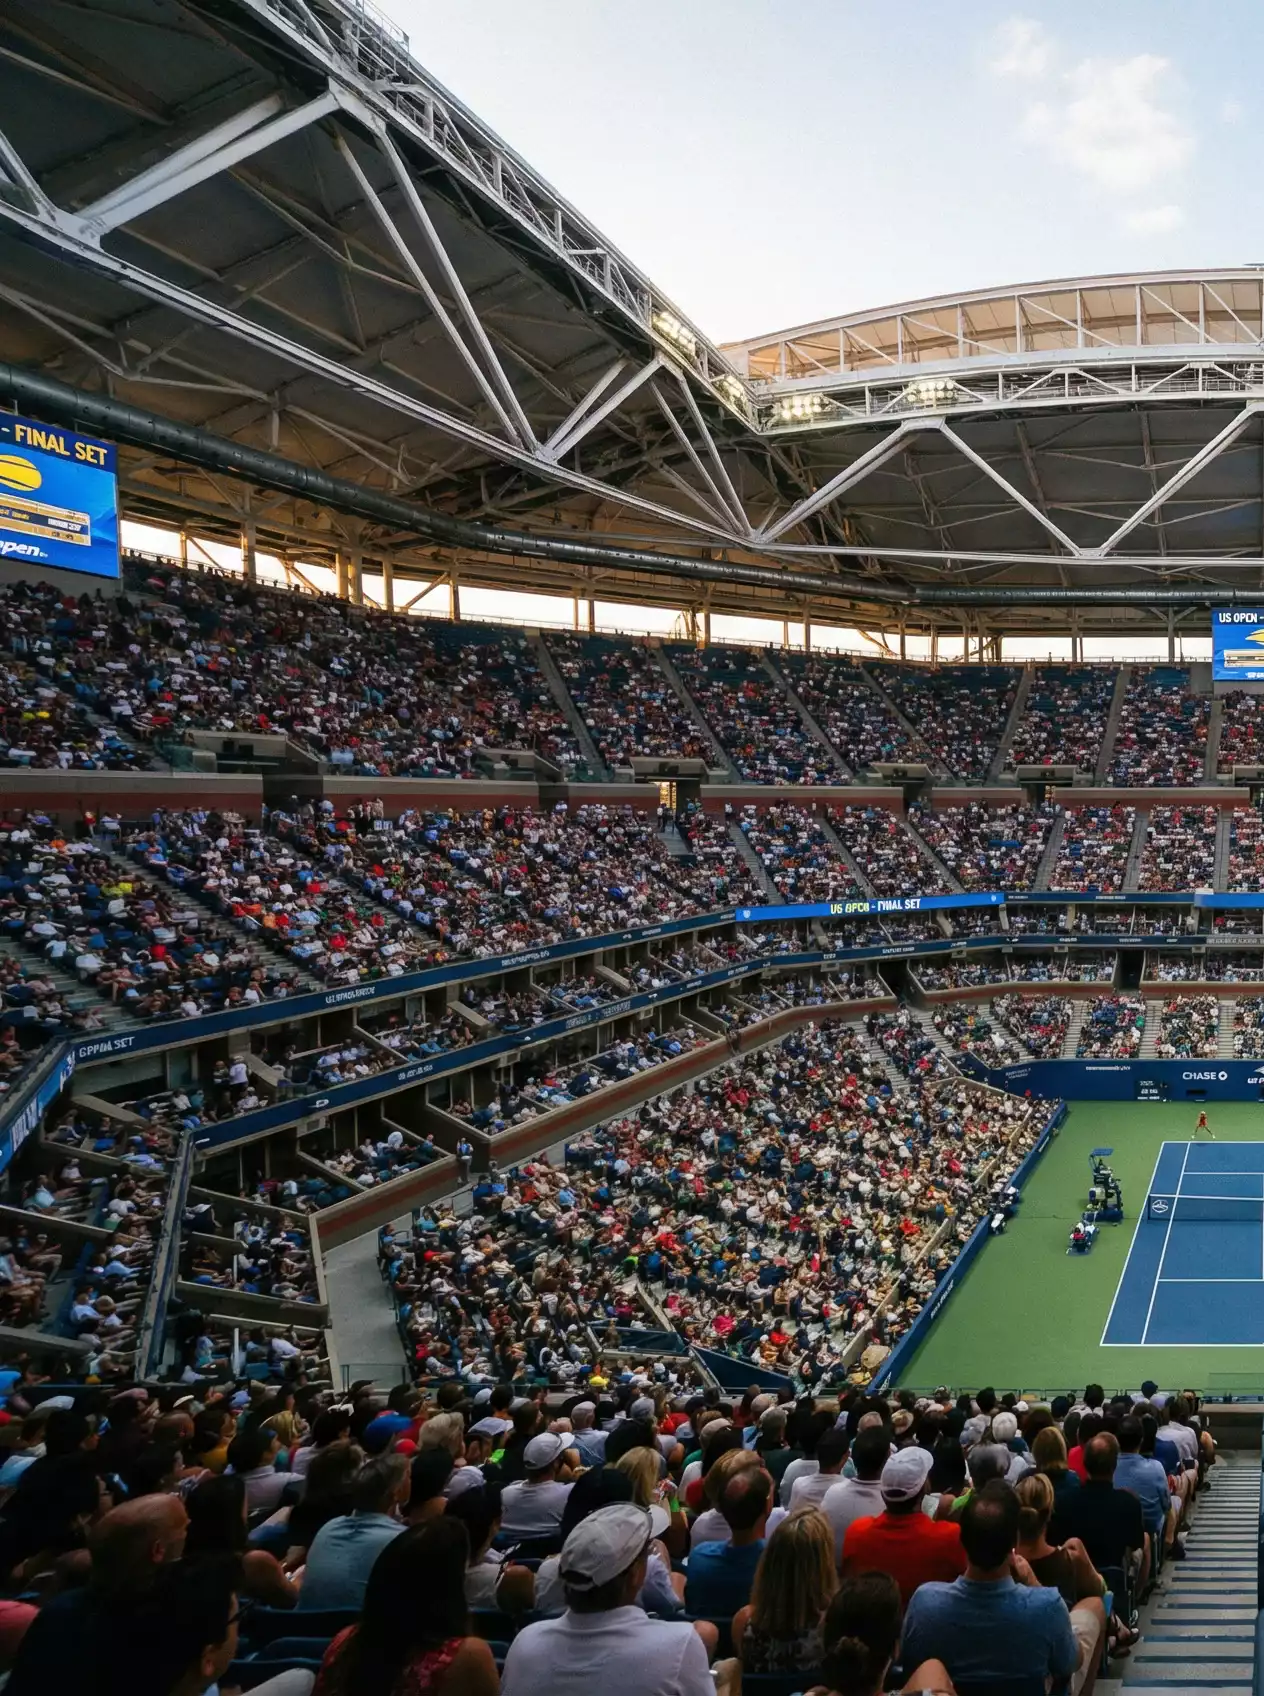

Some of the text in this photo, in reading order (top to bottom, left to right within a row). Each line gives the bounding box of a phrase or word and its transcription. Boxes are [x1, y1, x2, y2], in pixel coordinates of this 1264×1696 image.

[15, 424, 70, 456] FINAL
[75, 442, 108, 466] SET
[0, 540, 40, 557] pen
[1219, 612, 1232, 623] US
[904, 898, 921, 910] SET
[1182, 1071, 1217, 1080] CHASE
